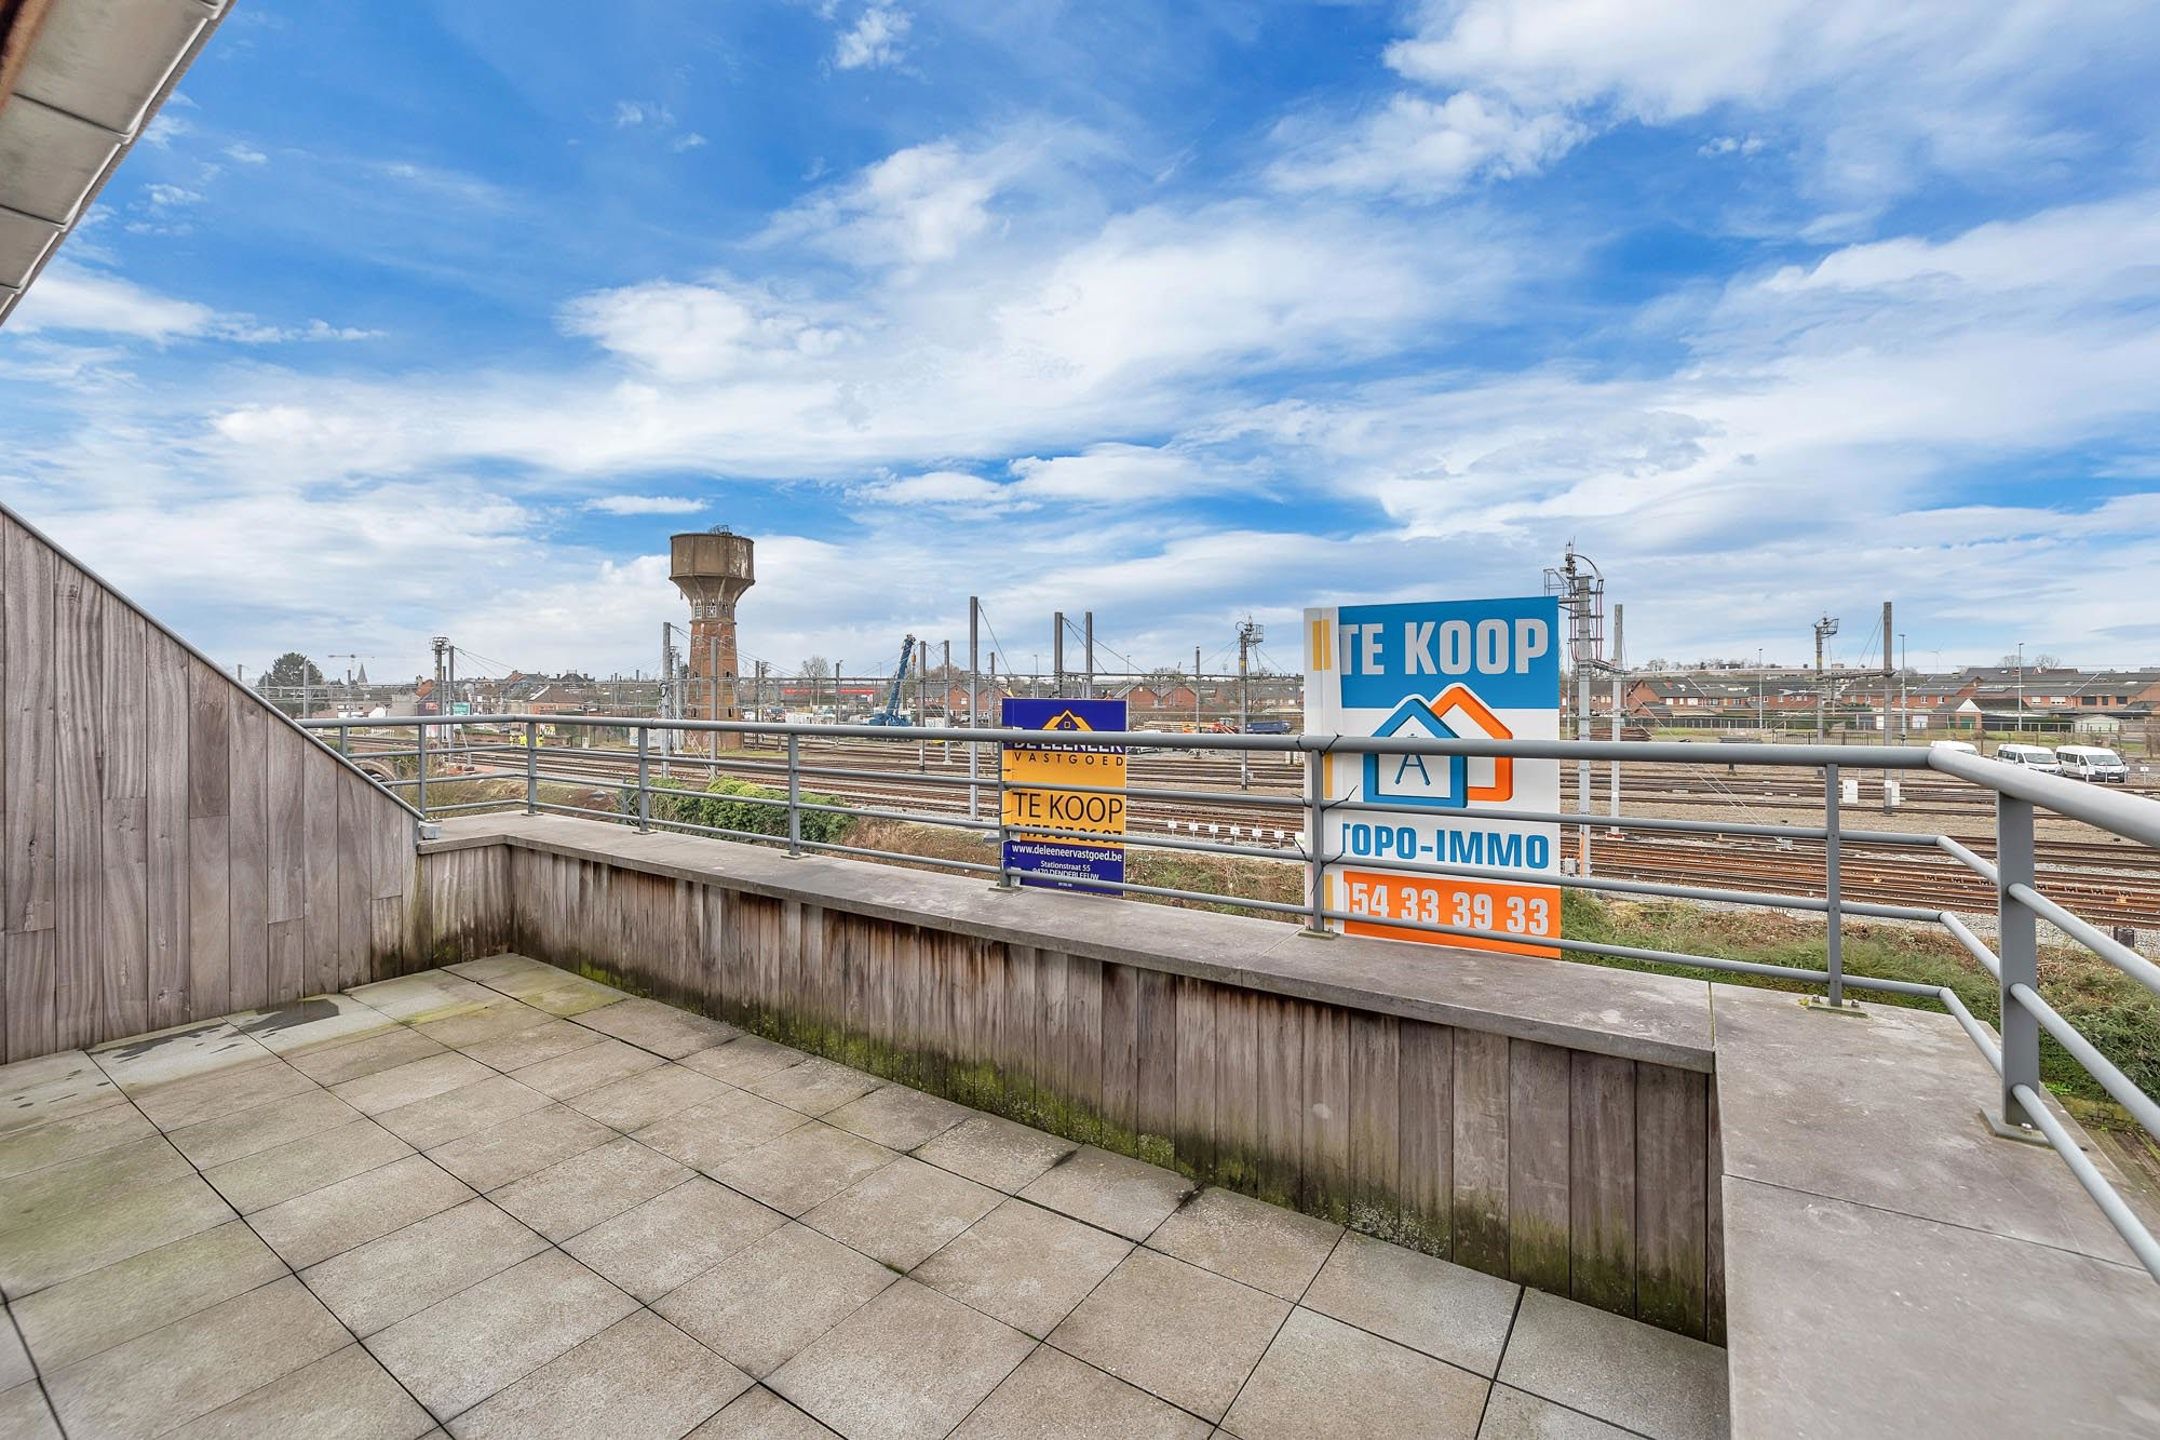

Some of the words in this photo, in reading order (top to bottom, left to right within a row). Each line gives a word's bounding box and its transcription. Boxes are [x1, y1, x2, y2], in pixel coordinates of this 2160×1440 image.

[1339, 623, 1384, 675] TE
[1405, 618, 1549, 675] KOOP
[1014, 751, 1124, 767] VASTGOED
[1012, 791, 1041, 819] TE
[1050, 794, 1123, 824] KOOP
[1011, 844, 1122, 862] www.deleeneervastgoed.be
[1040, 860, 1081, 871] Stationstraat
[1082, 864, 1091, 872] 55
[1401, 886, 1439, 927] 33
[1452, 891, 1493, 931] 39
[1506, 896, 1549, 936] 33
